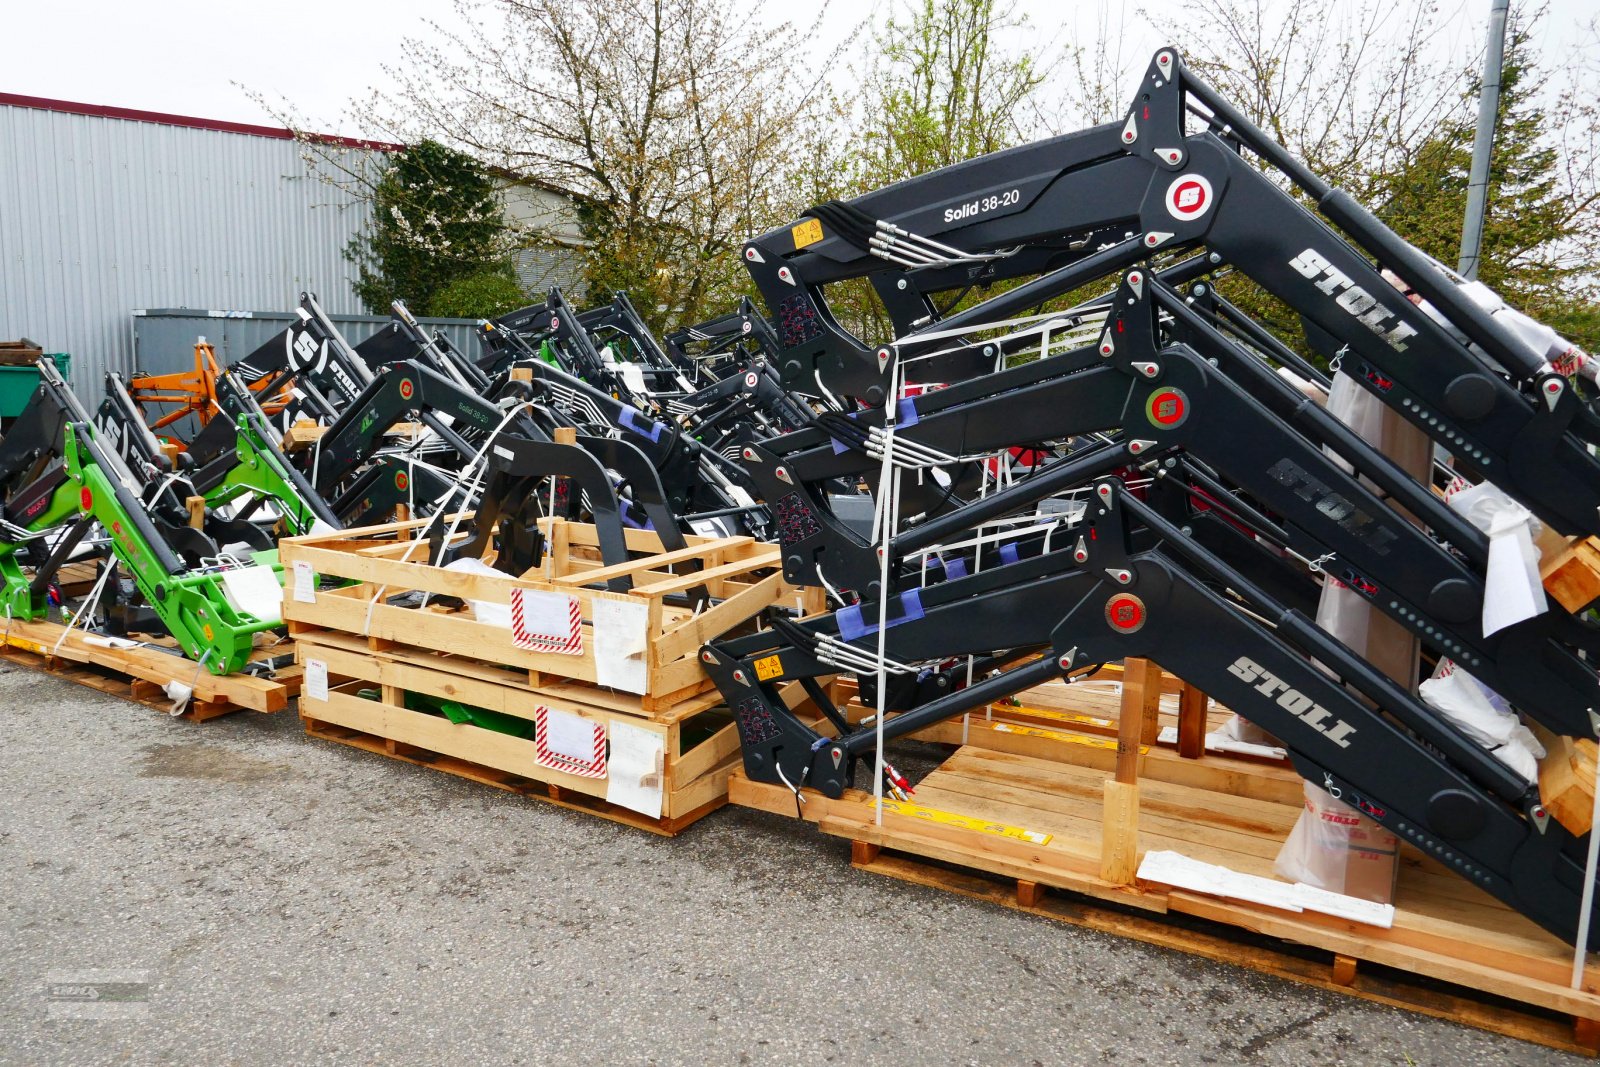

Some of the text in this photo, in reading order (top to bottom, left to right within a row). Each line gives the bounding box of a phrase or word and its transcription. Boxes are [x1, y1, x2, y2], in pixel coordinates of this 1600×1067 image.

[943, 188, 1021, 223] Solid 38-20
[1288, 247, 1419, 353] STOLL
[328, 359, 362, 400] STOLL
[458, 400, 489, 425] Solid 38-20
[1266, 456, 1400, 557] STOLL
[1226, 655, 1359, 749] STOLL
[1319, 811, 1361, 826] STOLL
